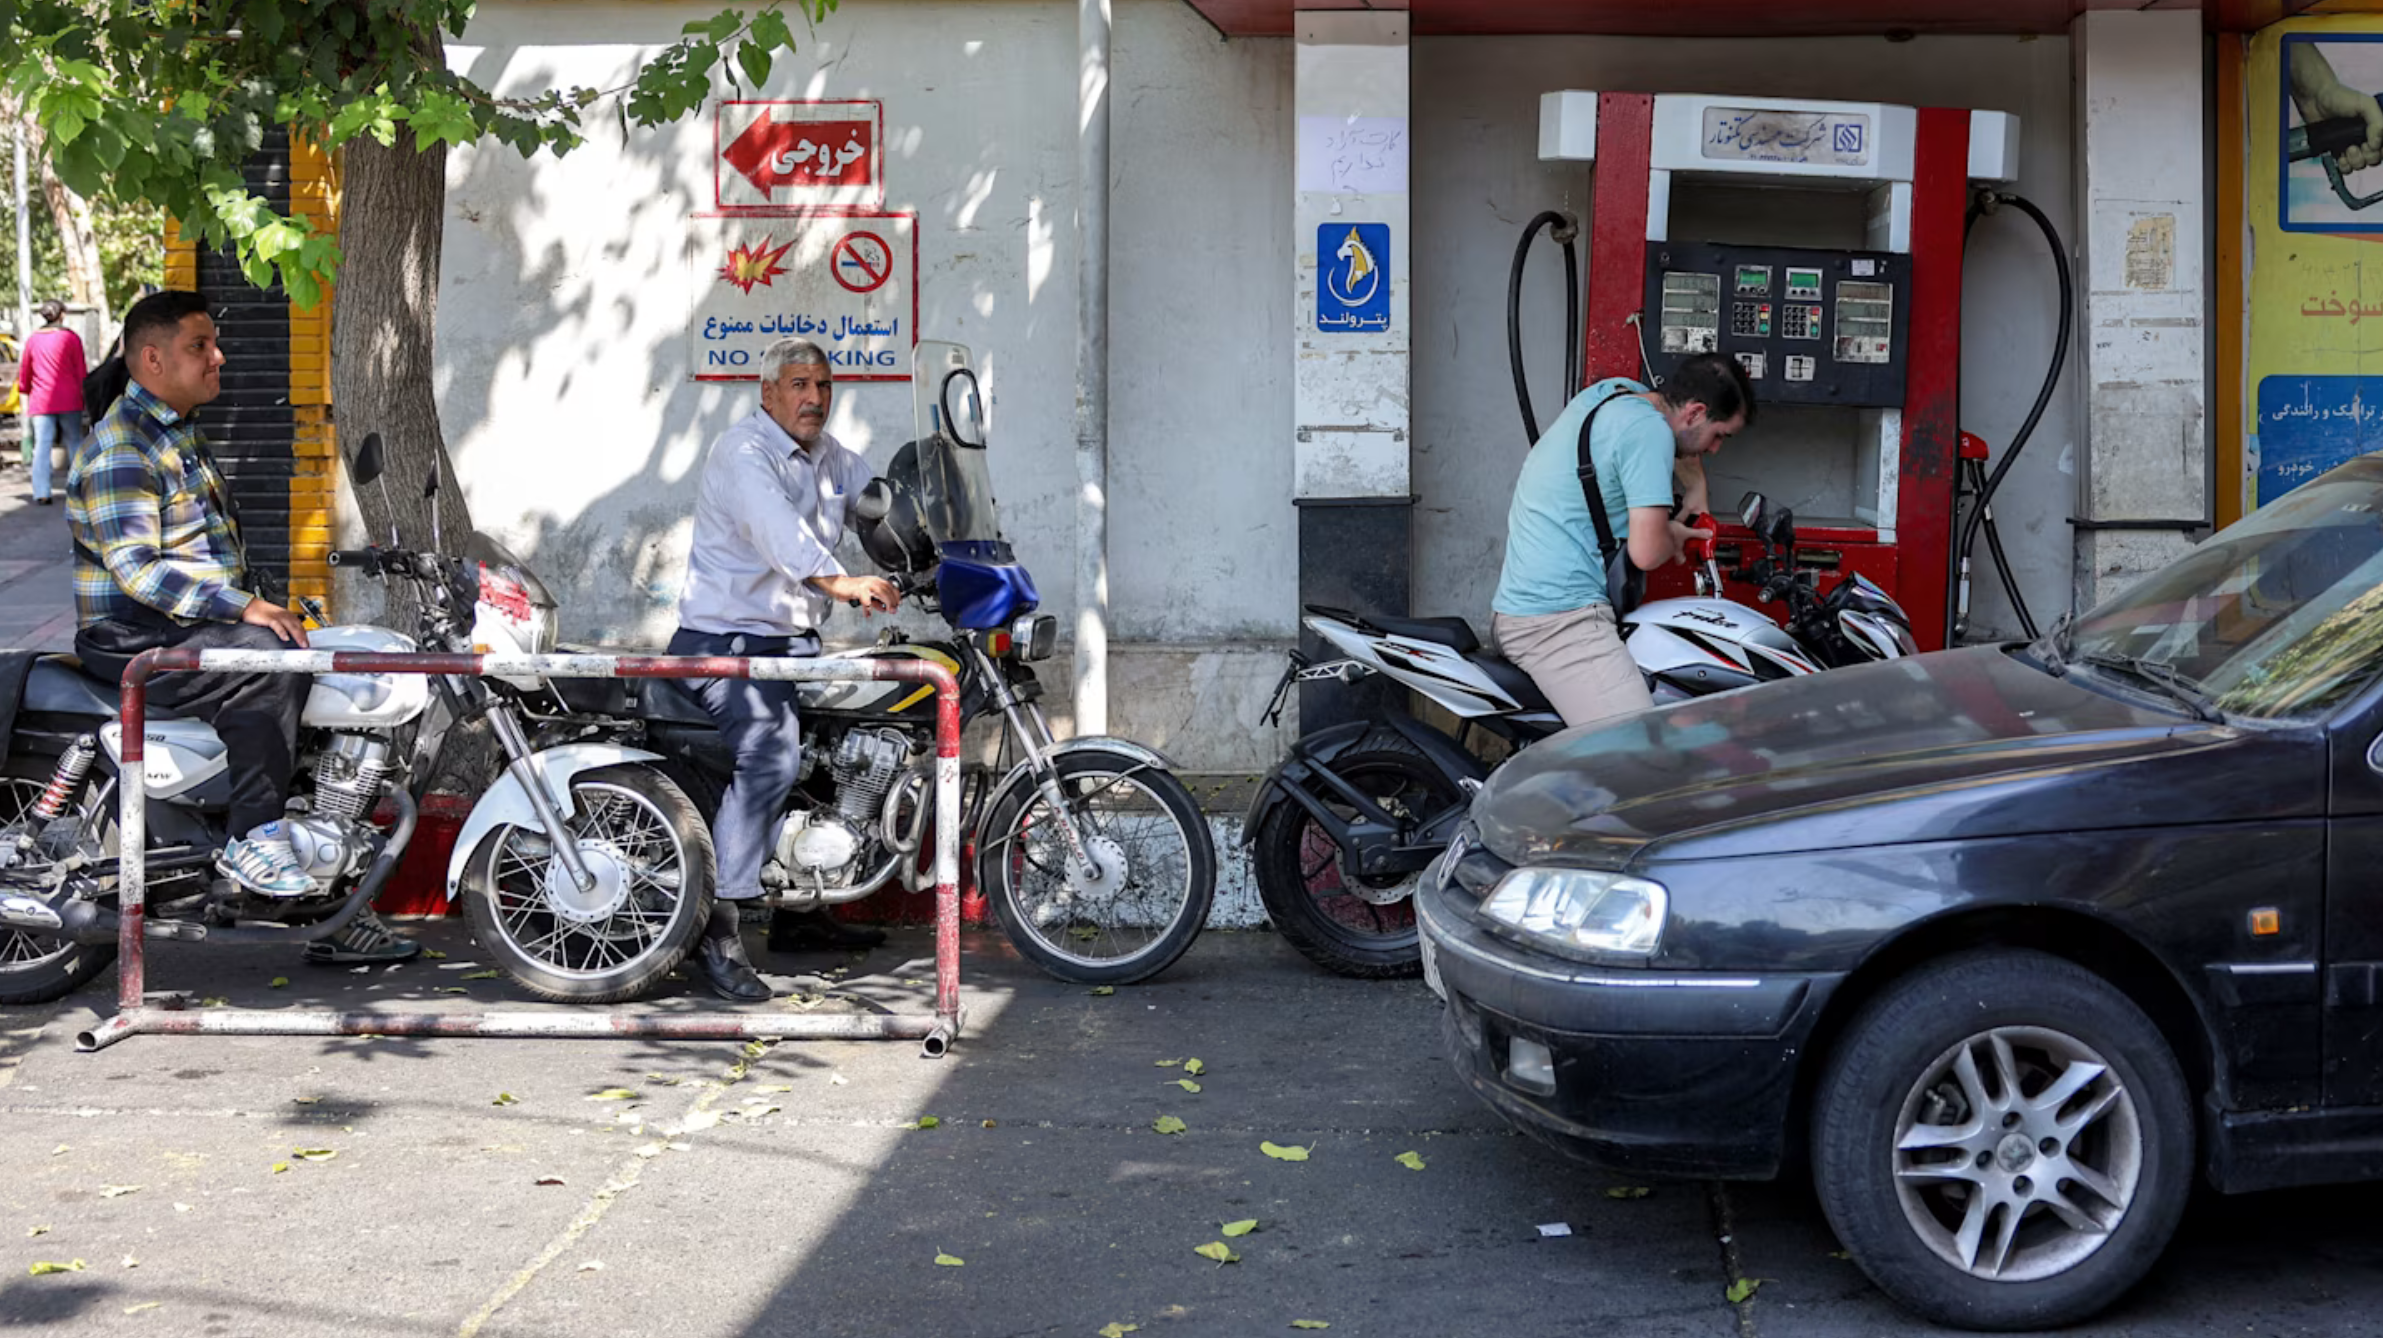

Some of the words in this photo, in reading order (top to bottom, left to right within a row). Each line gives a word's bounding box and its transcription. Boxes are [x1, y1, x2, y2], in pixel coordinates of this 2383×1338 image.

[1779, 114, 1826, 150] شرکت
[771, 129, 865, 176] خروجی
[2301, 290, 2383, 325] سوخت
[703, 315, 753, 339] ممنوع
[759, 313, 827, 338] دخانیات
[833, 316, 898, 341] استعمال
[1319, 311, 1388, 331] پترولند
[708, 350, 750, 366] NO
[2332, 403, 2376, 421] ترایک
